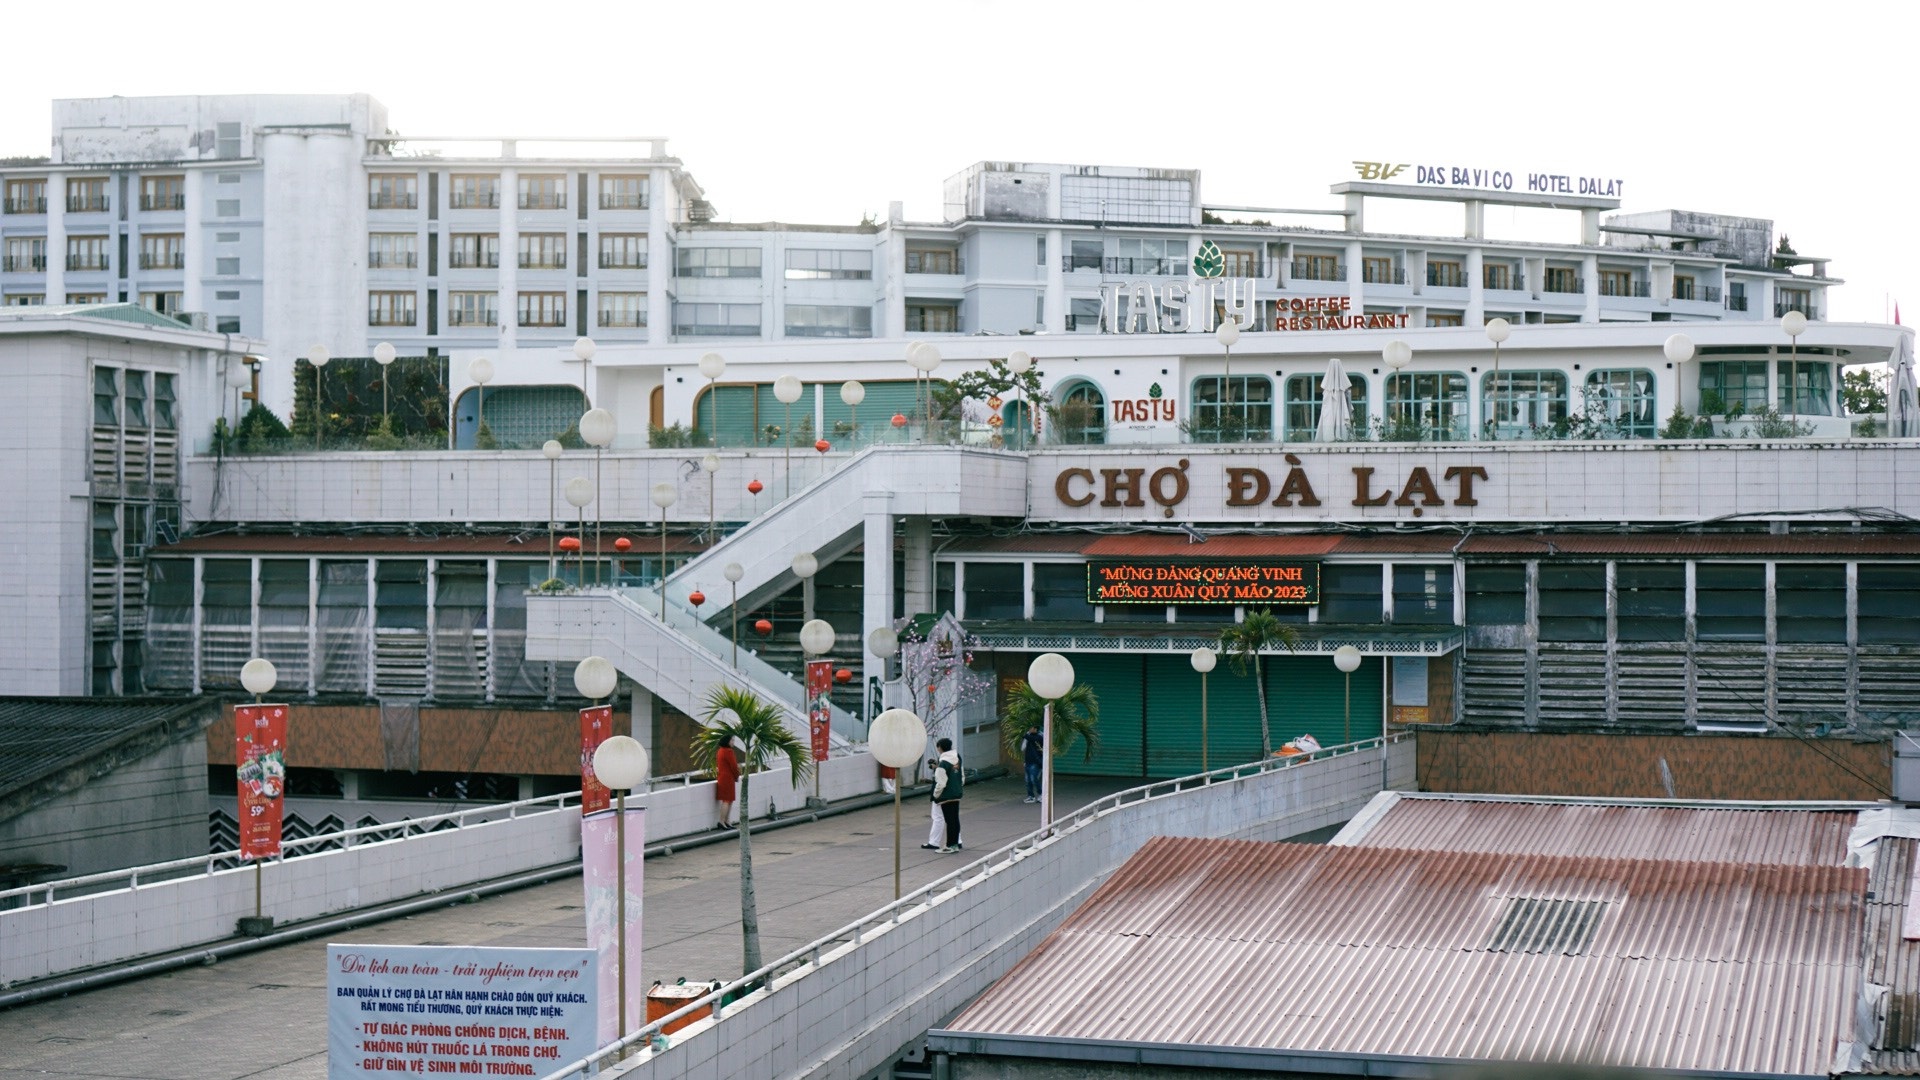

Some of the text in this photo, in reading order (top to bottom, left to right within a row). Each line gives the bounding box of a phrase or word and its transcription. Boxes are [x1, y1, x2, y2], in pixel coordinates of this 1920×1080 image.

[1417, 166, 1446, 185] DAS
[1528, 173, 1574, 193] HOTEL
[1579, 177, 1623, 197] DALAT
[1101, 278, 1256, 334] TASTY
[1276, 296, 1351, 312] COFFEE
[1276, 314, 1409, 331] RESTAURANT
[1111, 399, 1175, 422] TASTY
[1055, 453, 1489, 518] CHỢ ĐÀ LẠT
[1156, 565, 1200, 580] ĐẢNG
[1262, 568, 1302, 580] VINH
[1151, 584, 1195, 598] XUÂN
[1198, 583, 1231, 601] QUÝ
[1234, 584, 1269, 598] MÃO
[1274, 585, 1306, 599] 2023
[368, 958, 388, 977] lịch
[392, 965, 408, 974] an
[412, 961, 438, 975] toàn
[453, 963, 477, 976] trải
[479, 962, 525, 985] nghiệm
[528, 966, 553, 981] trọn
[337, 985, 587, 1004] BAN QUẢN LÝ CHỢ ĐÀ LẠT HÂN HẠNH CHÀO ĐÓN QUÝ KHÁCH.
[361, 1000, 563, 1018] RẤT MONG TIỂU THƯƠNG, QUÝ KHÁCH THỰC HIỆN:
[363, 1022, 378, 1036] TỰ
[381, 1022, 407, 1036] GIÁC
[411, 1022, 451, 1037] PHÒNG
[455, 1022, 495, 1038] CHỐNG
[499, 1027, 530, 1041] DỊCH,
[534, 1026, 569, 1041] BỆNH.
[363, 1039, 403, 1053] KHÔNG
[407, 1040, 428, 1054] HÚT
[431, 1040, 469, 1055] THUỐC
[473, 1042, 487, 1056] LÁ
[491, 1045, 529, 1057] TRONG
[534, 1046, 561, 1060] CHỢ.
[363, 1057, 384, 1070] GIỮ
[387, 1058, 406, 1071] GÌN
[411, 1058, 424, 1074] VỆ
[428, 1061, 456, 1073] SINH
[460, 1060, 482, 1074] MÔI
[486, 1061, 536, 1075] TRƯỜNG.
